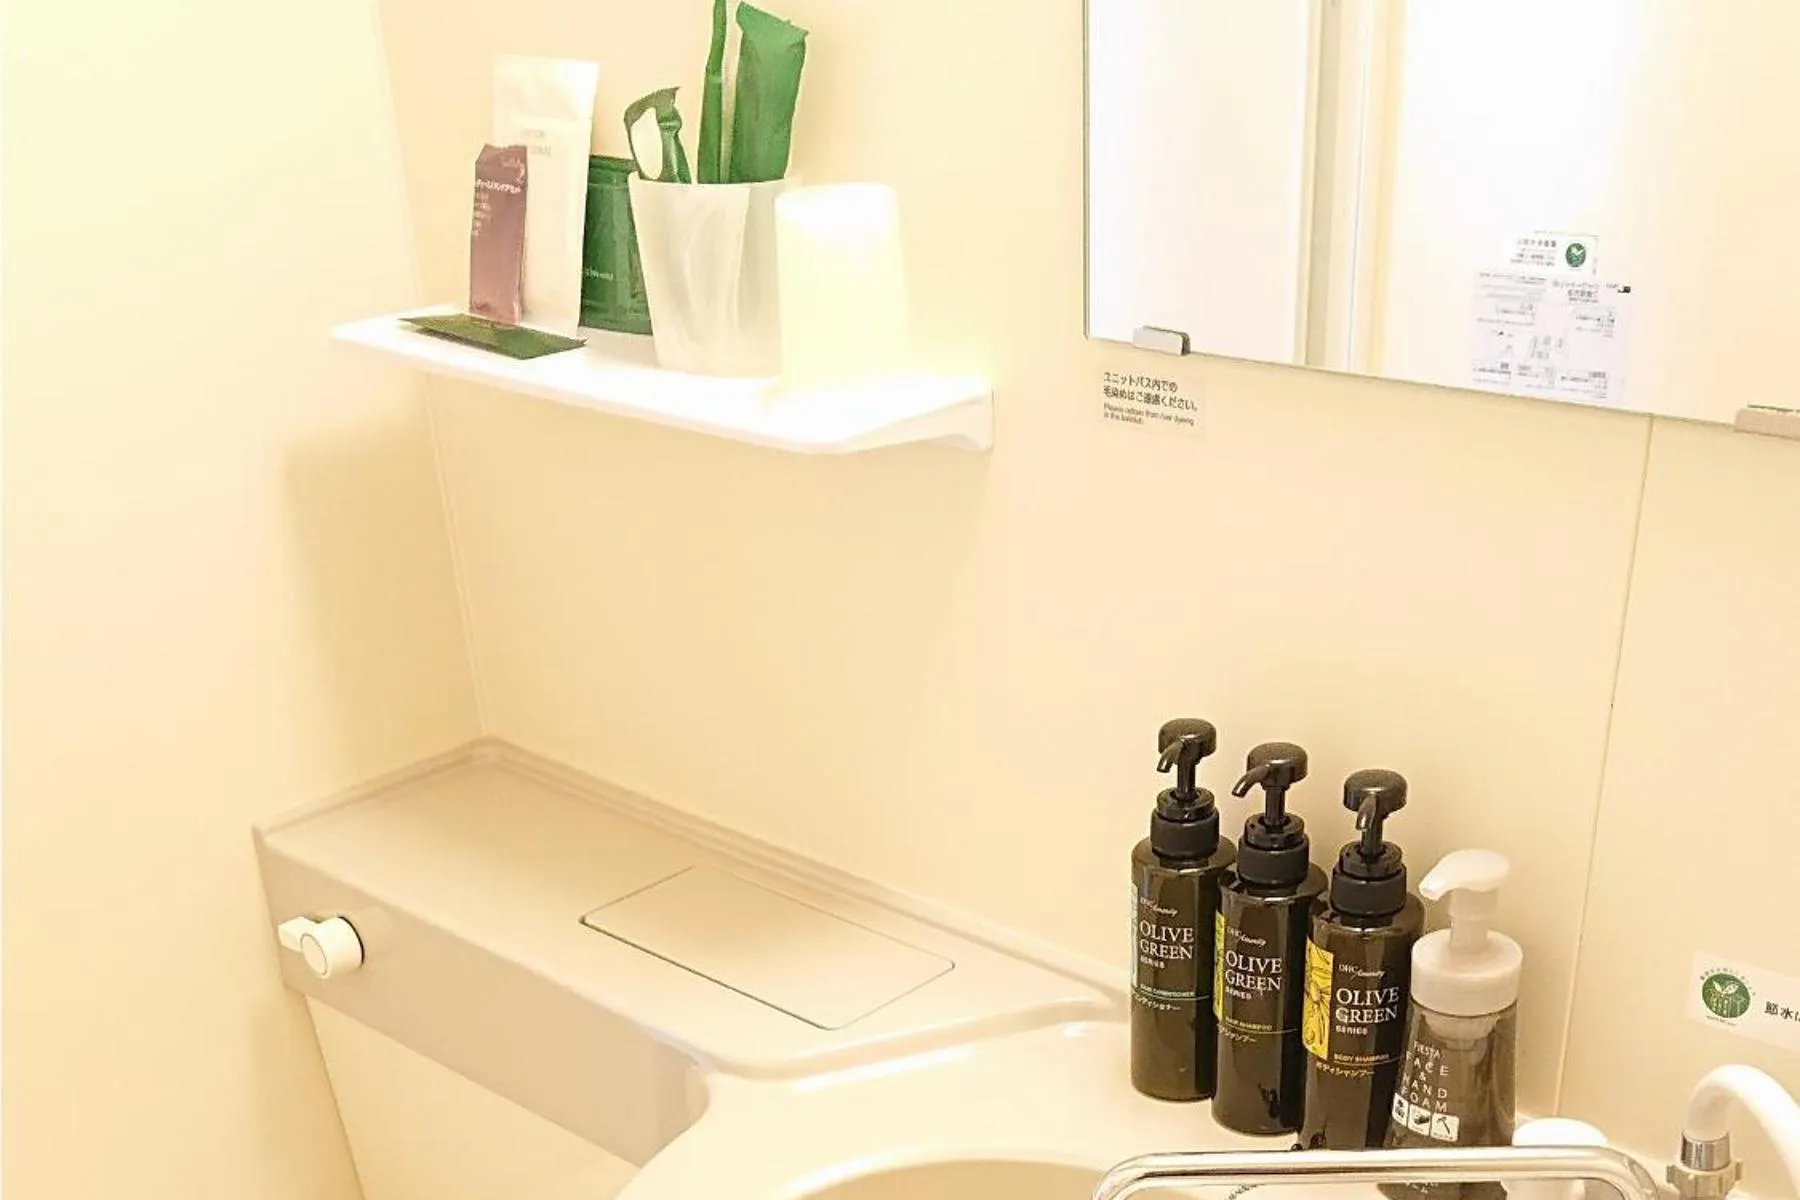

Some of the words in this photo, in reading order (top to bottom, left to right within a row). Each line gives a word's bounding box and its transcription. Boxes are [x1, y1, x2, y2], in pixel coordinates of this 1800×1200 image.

[1140, 919, 1194, 943] OLIVE
[1140, 938, 1194, 960] GREEN
[1225, 949, 1283, 974] OLIVE
[1225, 969, 1282, 992] GREEN
[1335, 986, 1400, 1006] OLIVE
[1335, 1005, 1398, 1024] GREEN
[1405, 1051, 1449, 1076] FACE
[1402, 1072, 1448, 1099] HAND
[1400, 1086, 1448, 1113] FOAM
